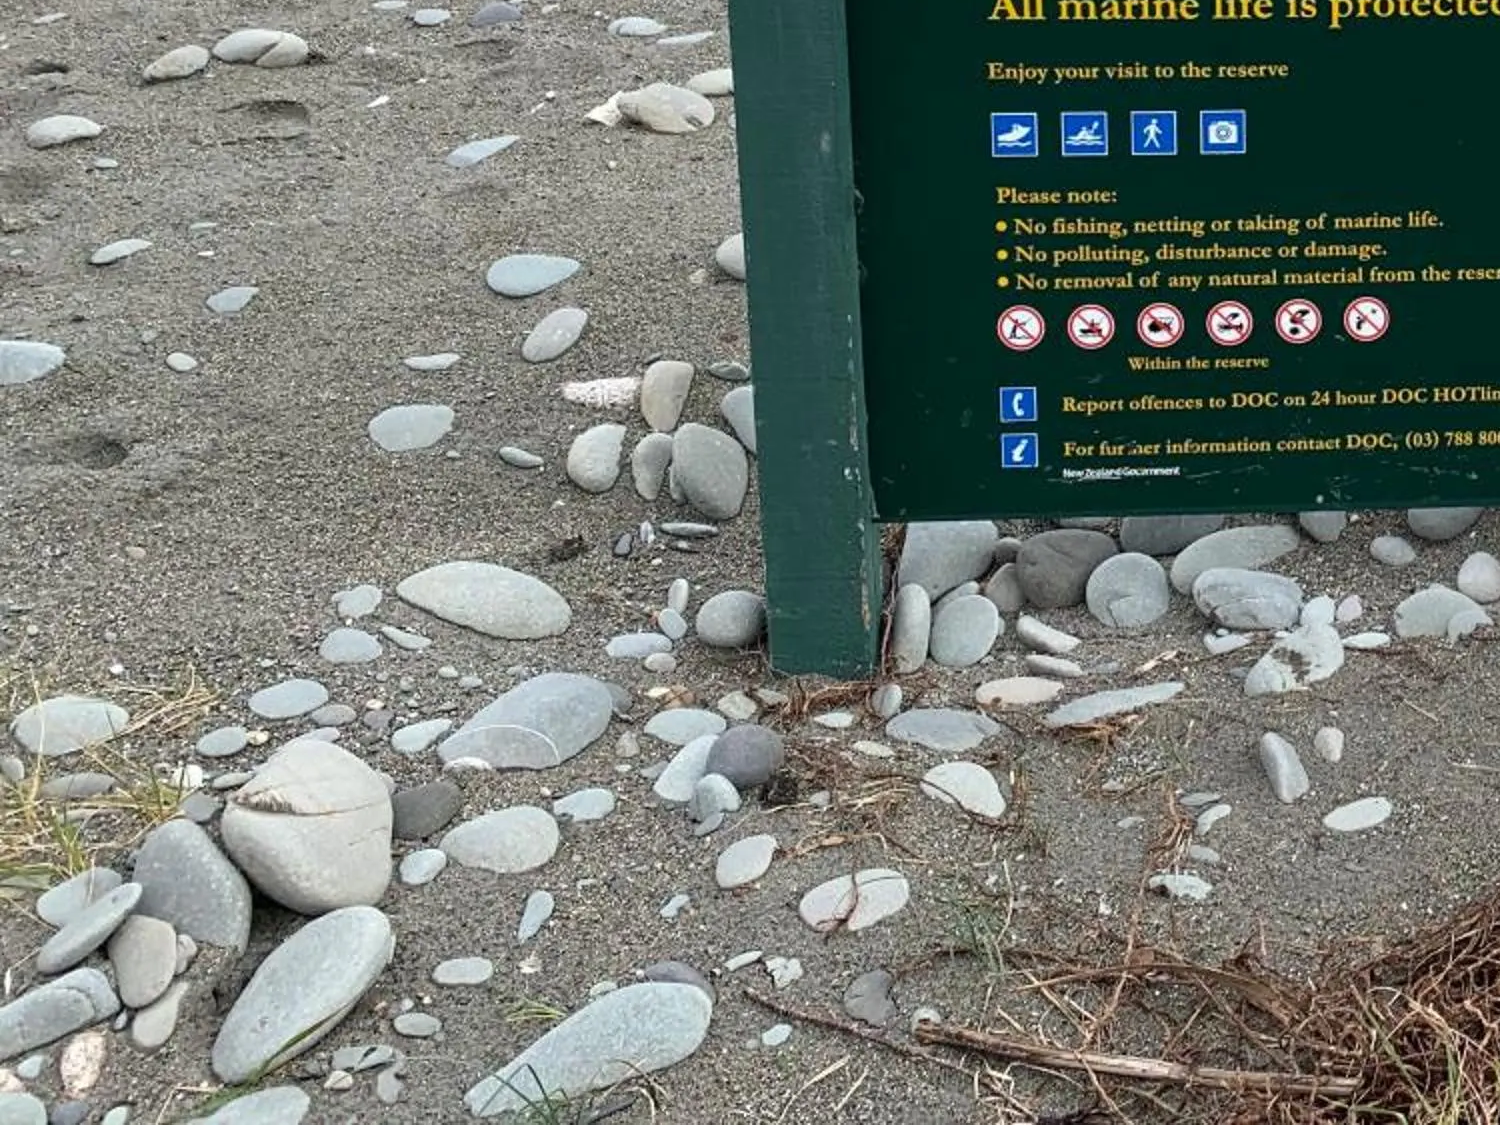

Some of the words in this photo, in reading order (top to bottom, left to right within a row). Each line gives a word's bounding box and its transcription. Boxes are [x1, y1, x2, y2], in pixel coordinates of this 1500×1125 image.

[987, 62, 1048, 85] Enjoy
[1053, 66, 1100, 85] your
[1105, 62, 1149, 79] visit
[1154, 65, 1175, 78] to
[1180, 61, 1212, 78] the
[1218, 64, 1289, 78] reserve
[996, 187, 1061, 204] Please
[1067, 190, 1117, 204] note:
[1013, 218, 1047, 234] No
[1052, 217, 1128, 238] fishing,
[1133, 215, 1205, 237] netting
[1210, 219, 1232, 232] or
[1237, 214, 1301, 236] taking
[1305, 212, 1327, 230] of
[1334, 212, 1403, 229] marine
[1408, 210, 1443, 228] life.
[1015, 245, 1047, 262] No
[1053, 244, 1149, 266] polluting,
[1155, 242, 1272, 260] disturbance
[1277, 246, 1299, 258] or
[1303, 240, 1387, 262] damage.
[1015, 273, 1048, 290] No
[1053, 271, 1134, 289] removal
[1138, 270, 1161, 288] of
[1168, 275, 1203, 292] any
[1208, 268, 1277, 286] natural
[1283, 266, 1363, 284] material
[1369, 266, 1416, 283] from
[1421, 265, 1451, 282] the
[1128, 356, 1181, 370] Within
[1185, 356, 1210, 369] the
[1215, 358, 1269, 369] reserve
[1062, 395, 1124, 416] Report
[1129, 394, 1203, 410] offences
[1209, 396, 1227, 408] to
[1231, 392, 1278, 408] DOC
[1283, 396, 1306, 407] on
[1311, 390, 1331, 406] 24
[1335, 389, 1377, 405] hour
[1381, 387, 1428, 404] DOC
[1063, 442, 1095, 456] For
[1165, 436, 1271, 454] information
[1276, 436, 1342, 453] contact
[1346, 432, 1398, 451] DOC,
[1405, 430, 1440, 449] (03)
[1444, 431, 1473, 446] 788
[1062, 468, 1083, 478] New
